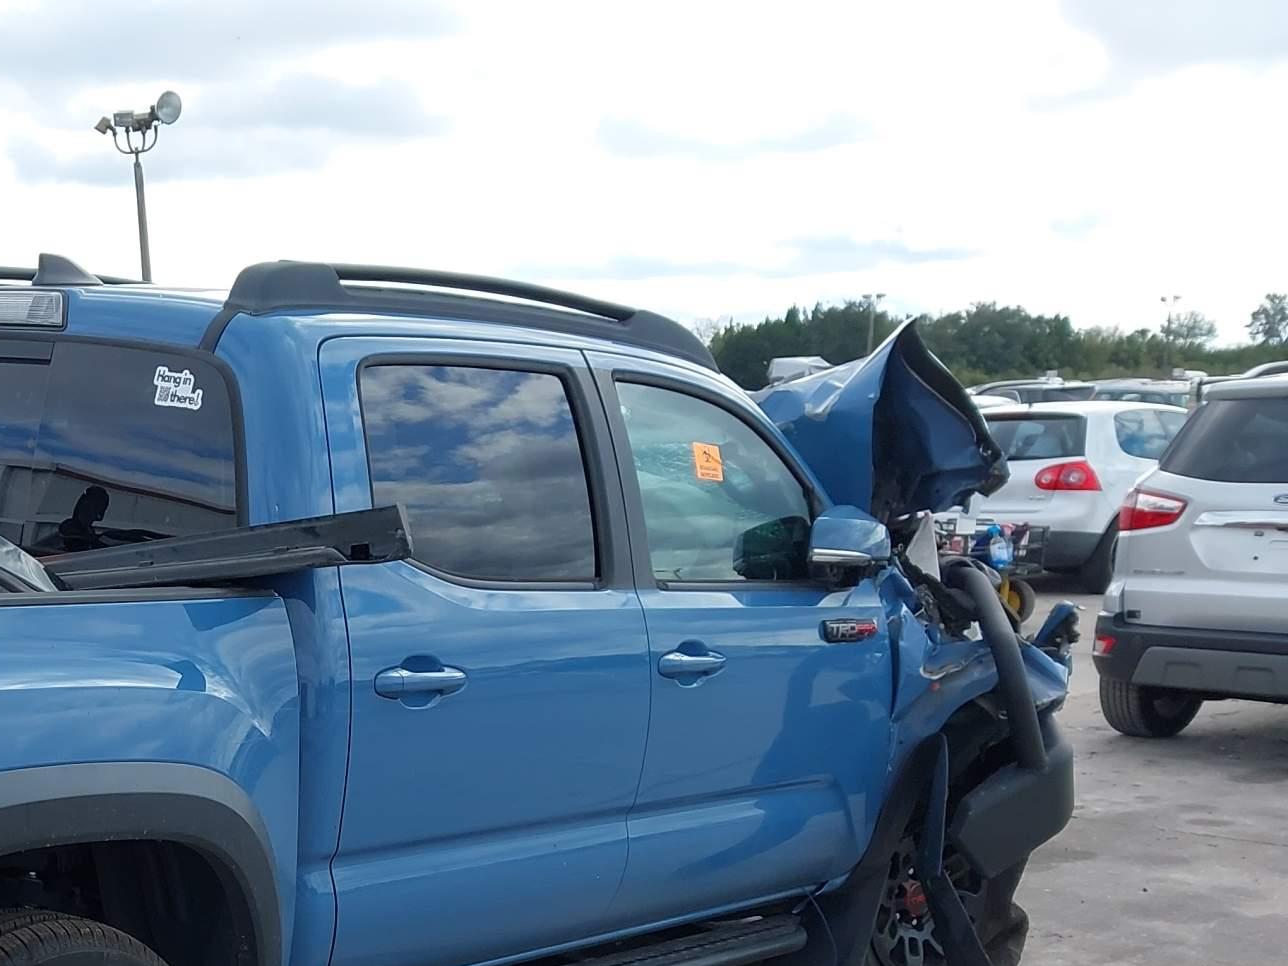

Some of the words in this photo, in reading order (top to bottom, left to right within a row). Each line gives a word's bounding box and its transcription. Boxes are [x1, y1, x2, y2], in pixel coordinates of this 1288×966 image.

[157, 369, 182, 387] Hang
[182, 372, 192, 385] in
[170, 390, 200, 406] there!
[828, 622, 856, 640] TRD
